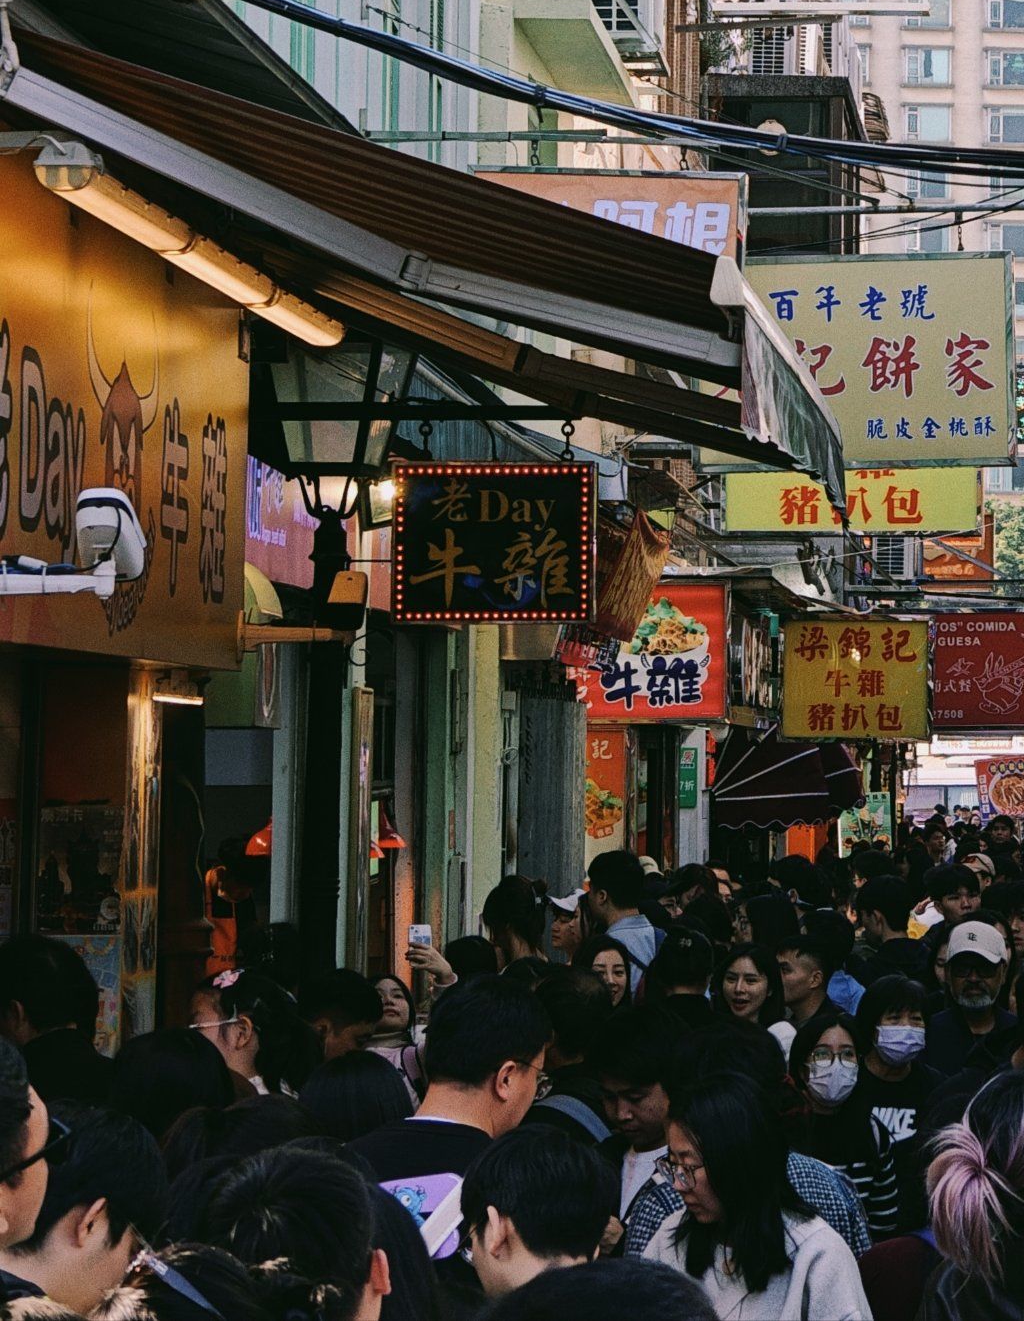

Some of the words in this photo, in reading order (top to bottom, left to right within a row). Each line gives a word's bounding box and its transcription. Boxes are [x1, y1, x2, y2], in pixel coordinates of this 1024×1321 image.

[768, 284, 937, 323] 百年老號
[866, 415, 997, 441] 脆皮金桃酥
[408, 529, 576, 610] 牛雜
[966, 621, 1017, 633] COMIDA
[795, 626, 918, 663] 梁錦記
[824, 668, 886, 699] 牛雜
[806, 702, 905, 733] 豬扒包
[871, 1106, 917, 1134] NIKE
